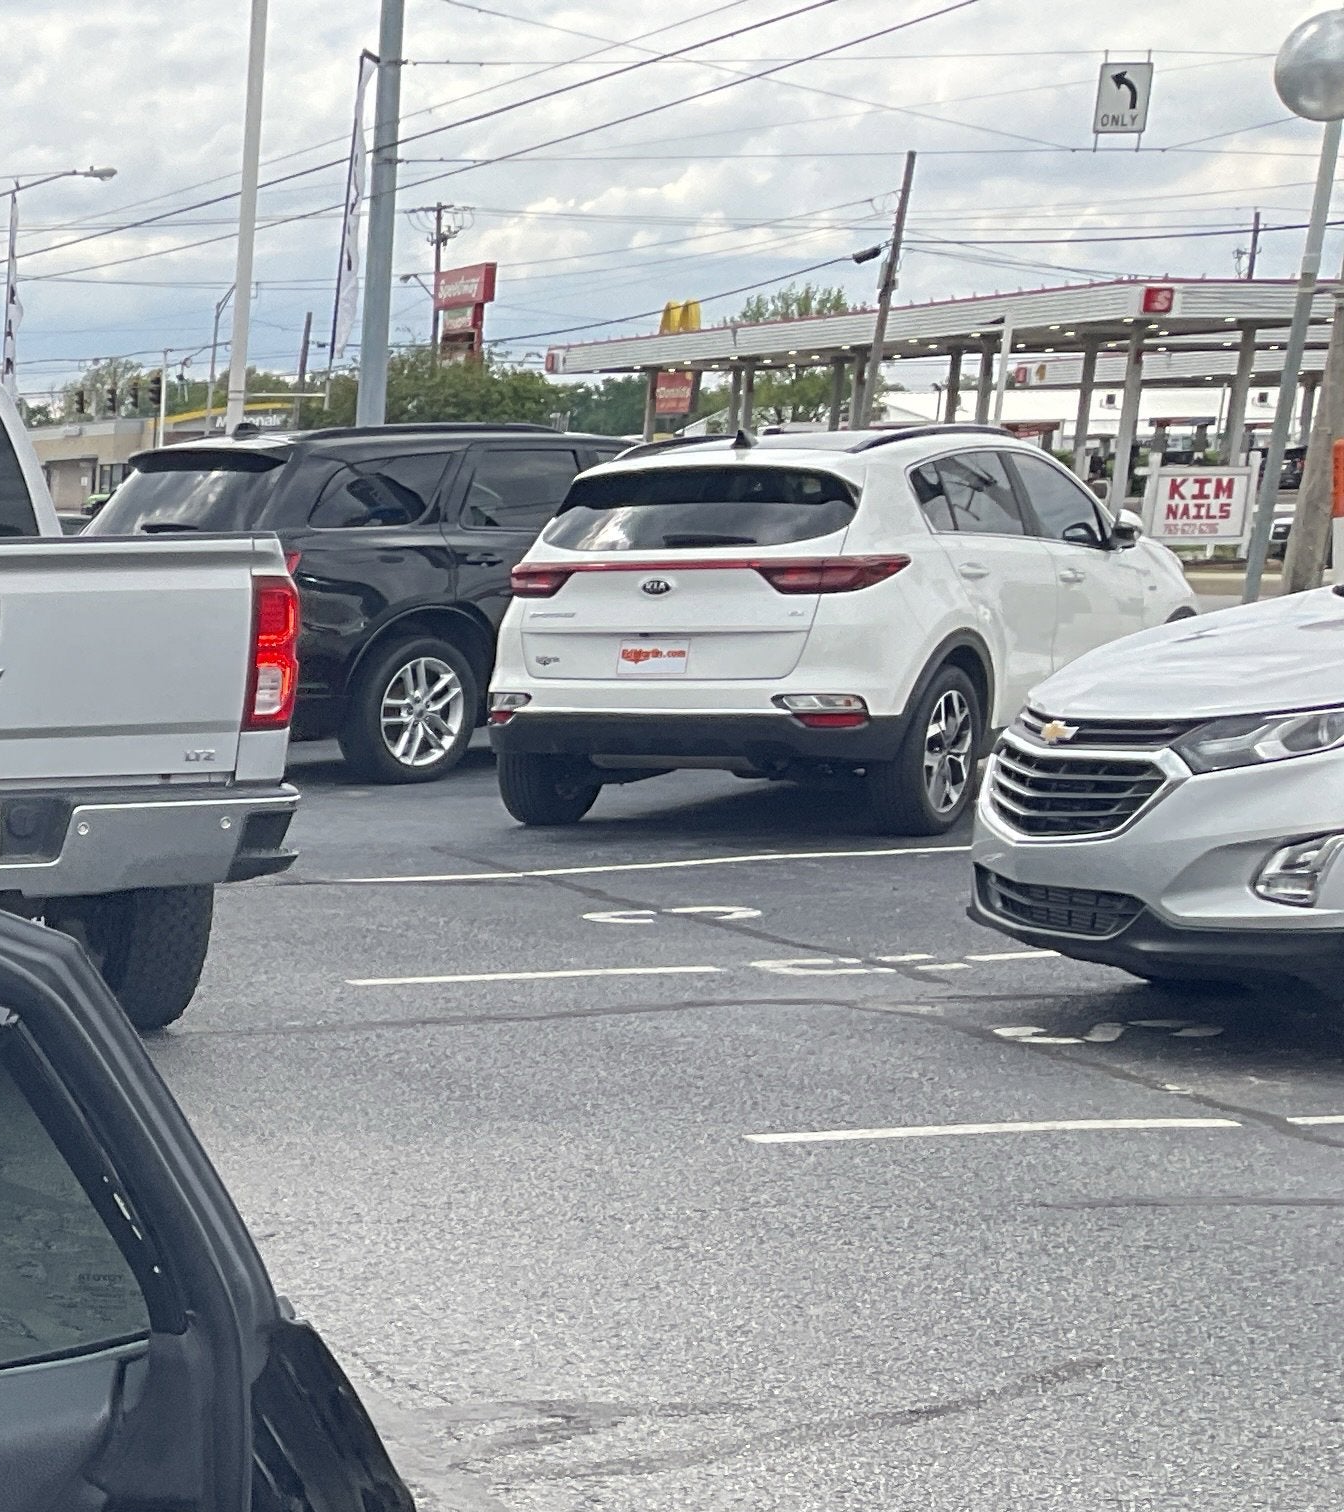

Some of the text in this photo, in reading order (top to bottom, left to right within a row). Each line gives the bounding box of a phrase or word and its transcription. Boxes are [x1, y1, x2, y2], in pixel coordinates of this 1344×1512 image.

[1100, 113, 1139, 127] ONLY
[1168, 477, 1235, 500] KIM
[1165, 503, 1232, 520] NAILS
[184, 749, 216, 762] LTZ
